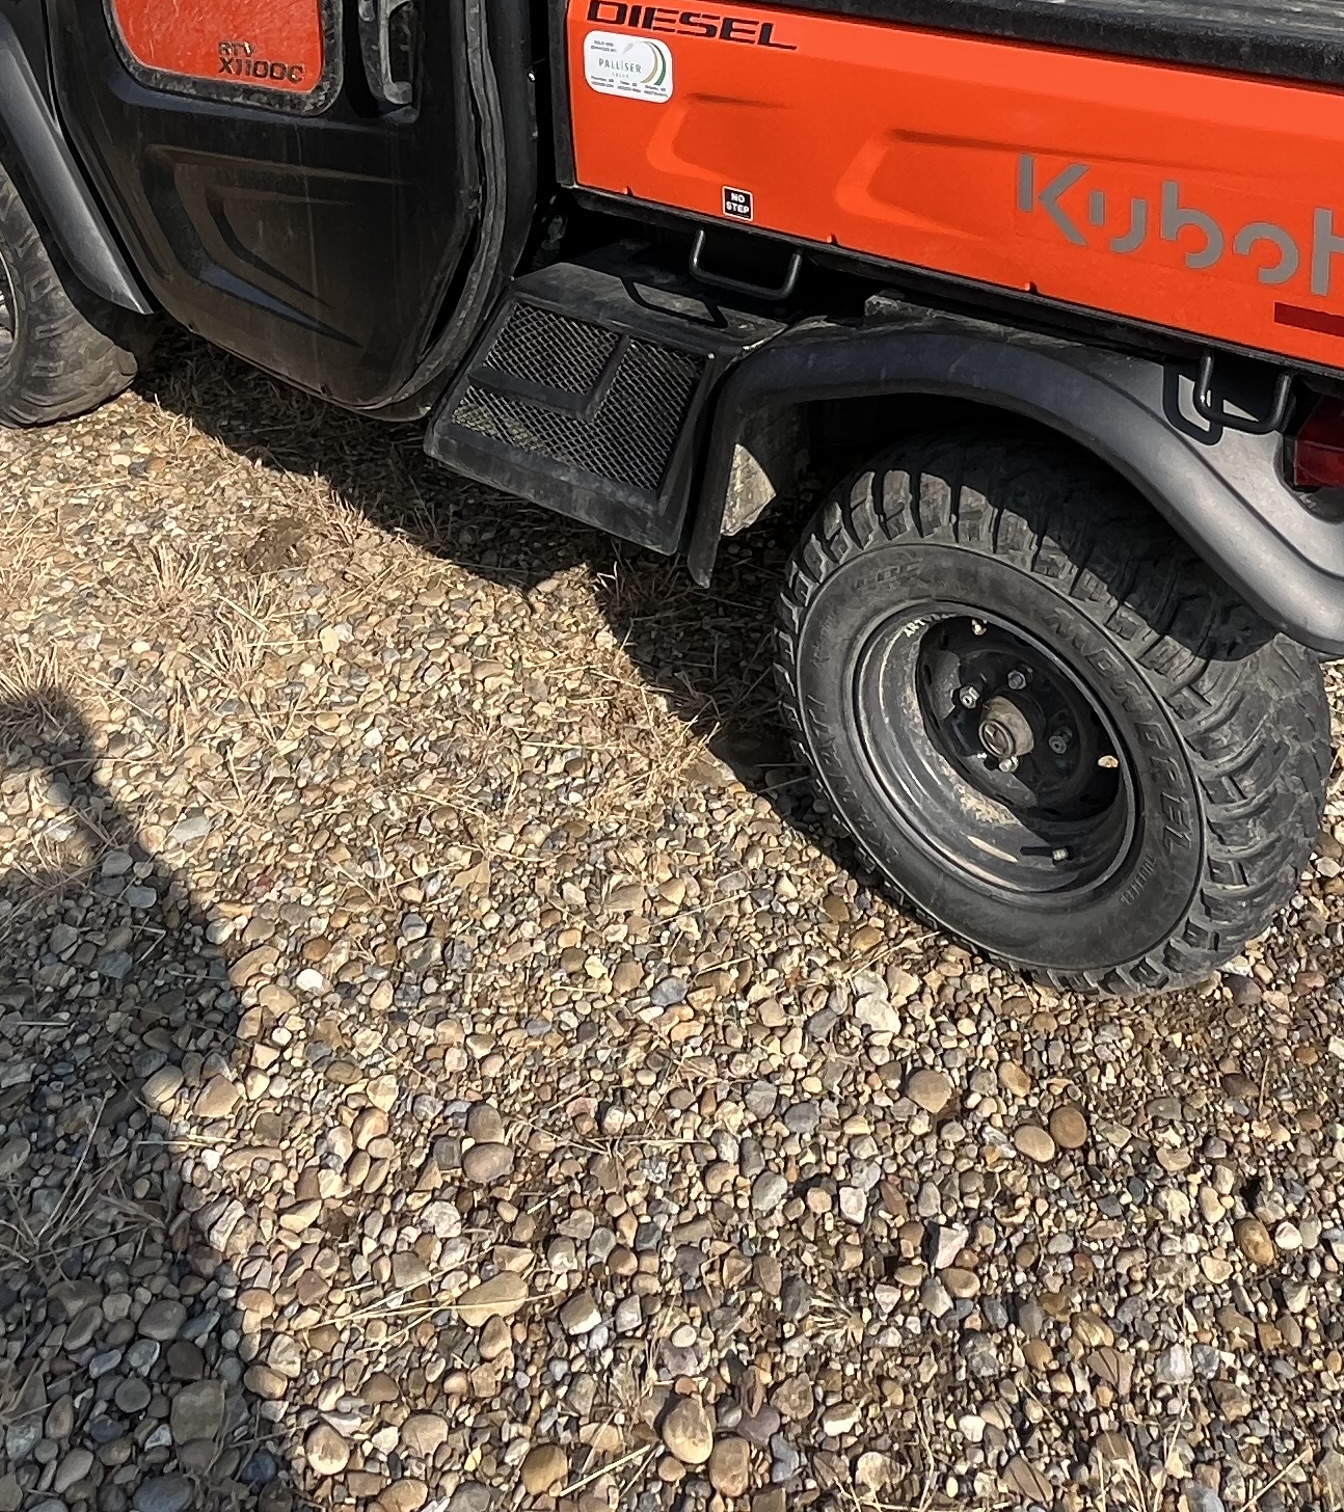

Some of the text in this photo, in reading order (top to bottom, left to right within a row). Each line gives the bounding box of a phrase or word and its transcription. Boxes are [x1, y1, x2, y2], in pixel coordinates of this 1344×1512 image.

[587, 0, 798, 51] DIESEL
[218, 57, 304, 84] X1100C
[726, 200, 750, 214] STEP
[731, 192, 746, 204] NO
